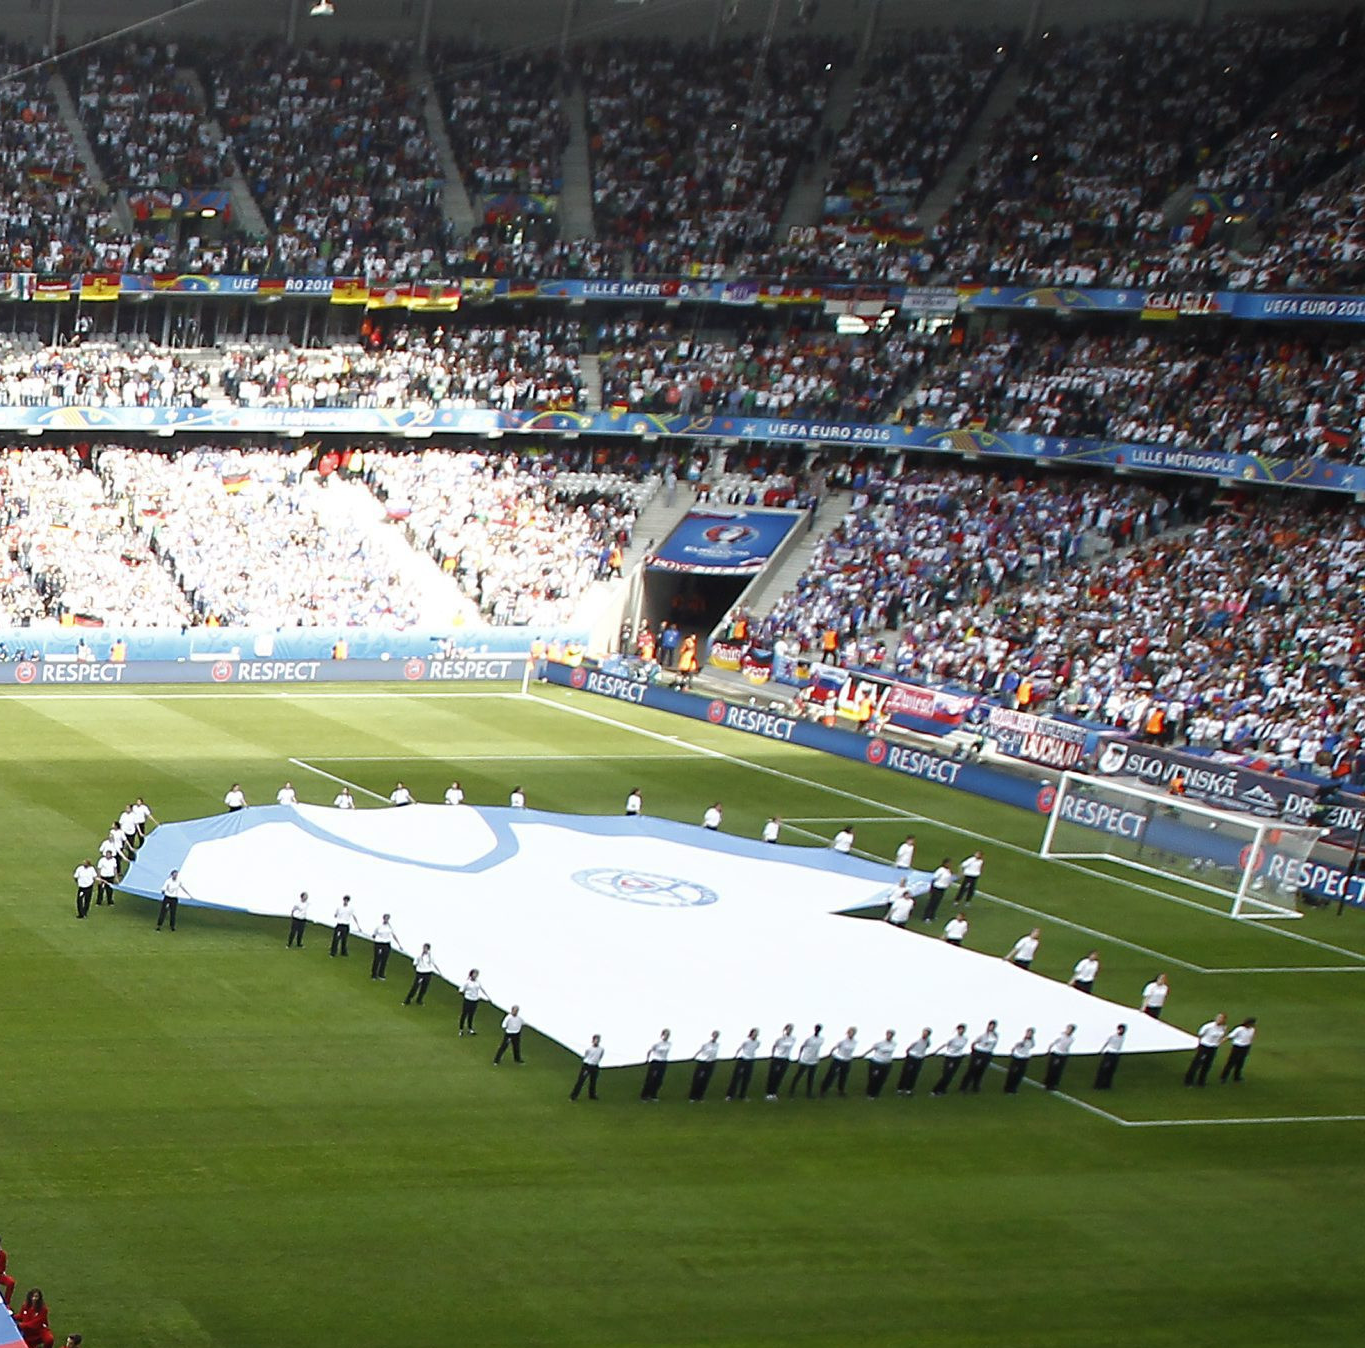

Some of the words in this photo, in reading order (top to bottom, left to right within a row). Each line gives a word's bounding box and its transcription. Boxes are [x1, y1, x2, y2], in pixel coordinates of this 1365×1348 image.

[583, 283, 620, 296] LILLE
[1264, 299, 1298, 314] UEFA
[1300, 300, 1336, 316] EURO
[1337, 301, 1365, 317] 201
[768, 424, 807, 439] UEFA
[809, 426, 851, 441] EURO
[853, 428, 891, 442] 2016
[1132, 450, 1163, 464] LILLE
[1165, 451, 1237, 473] MÉTROPOLE
[42, 662, 126, 682] RESPECT
[237, 661, 320, 681] RESPECT
[429, 659, 512, 680] RESPECT
[587, 672, 648, 703] RESPECT
[728, 704, 796, 742] RESPECT
[887, 745, 961, 785] RESPECT
[1126, 752, 1238, 798] SLOVENSKÁ
[1062, 793, 1147, 840] RESPECT
